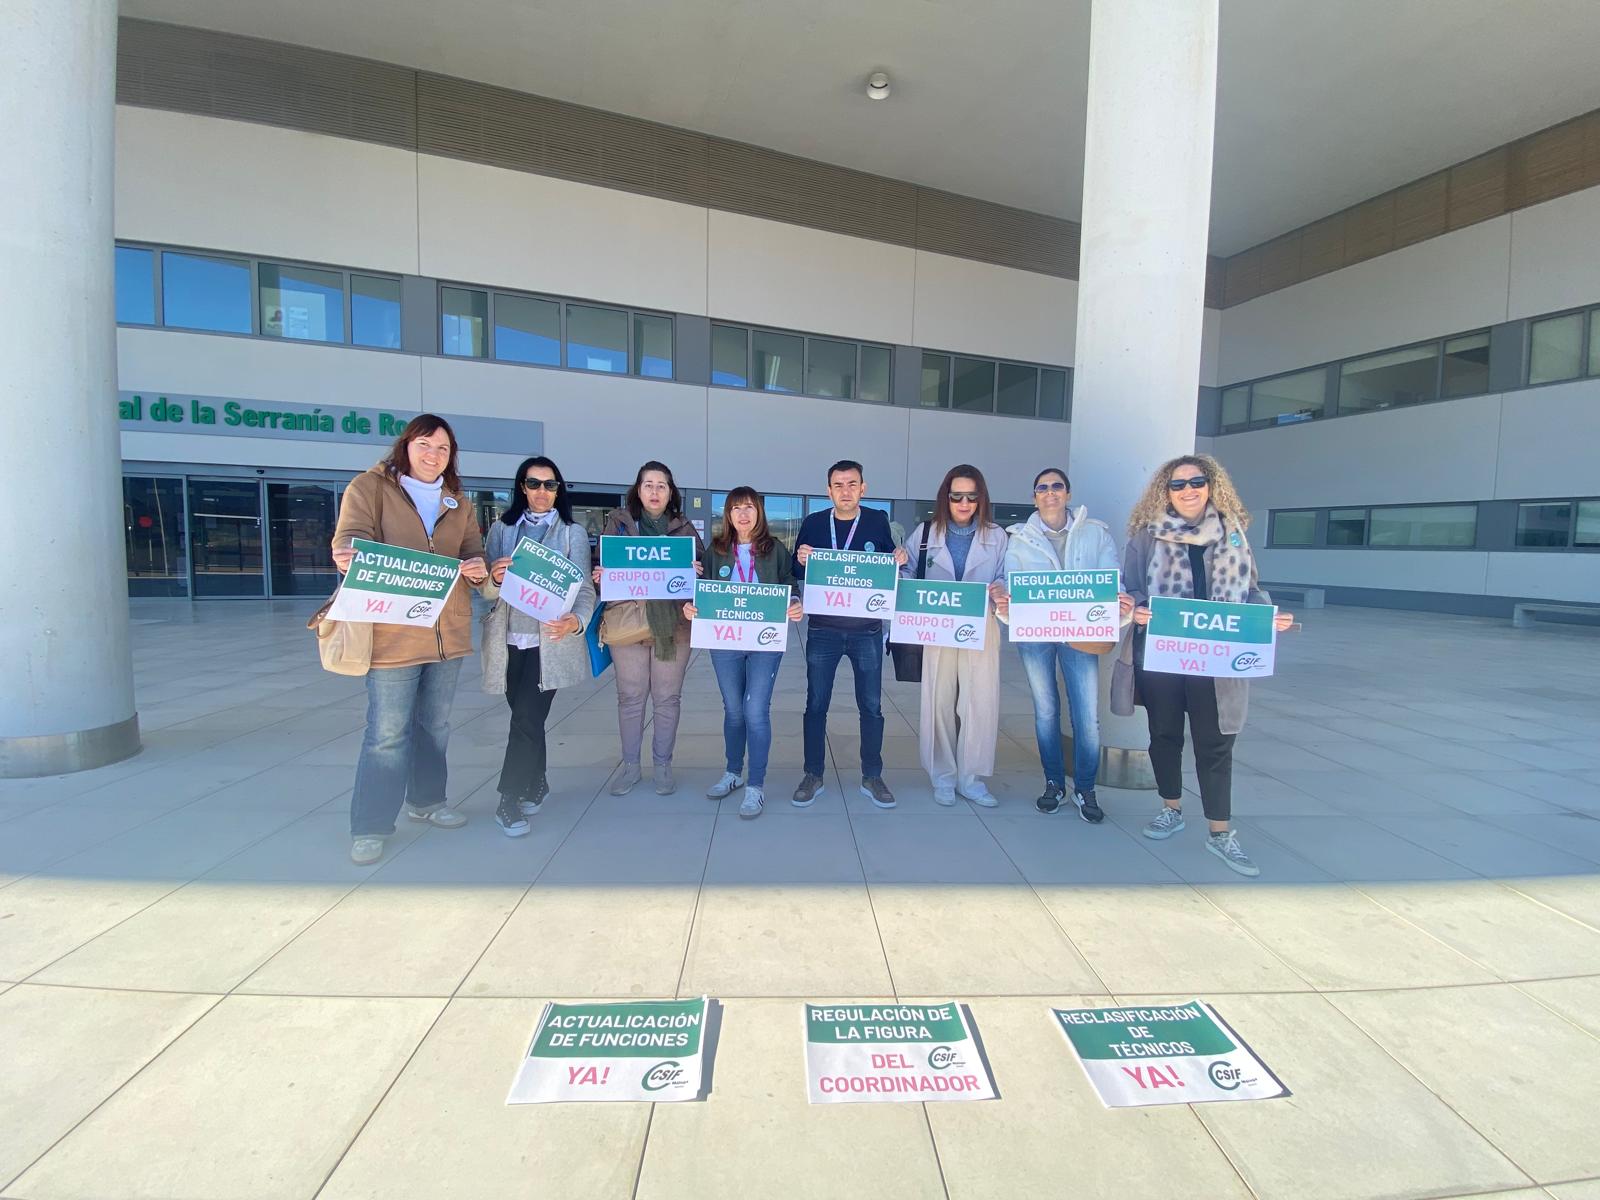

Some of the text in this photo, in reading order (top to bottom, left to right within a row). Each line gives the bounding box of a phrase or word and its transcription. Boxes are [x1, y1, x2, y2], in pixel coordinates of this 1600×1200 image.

[150, 397, 183, 423] de
[191, 400, 216, 425] la
[224, 402, 334, 432] Serranía
[342, 411, 370, 434] de
[625, 546, 671, 561] TCAE
[811, 551, 895, 565] RECLASIFICACIÓN
[354, 551, 457, 579] ACTUALICACIÓN
[844, 566, 857, 575] DE
[356, 569, 445, 592] DE FUNCIONES
[551, 570, 566, 583] DE
[608, 571, 665, 582] GRUPO C1
[826, 575, 873, 588] TÉCNICOS
[1013, 572, 1113, 586] REGULACIÓN DE
[518, 584, 549, 610] YA!
[628, 585, 648, 596] YA!
[699, 583, 785, 597] RECLASIFICACIÓN
[1028, 588, 1094, 600] LA FIGURA
[365, 598, 392, 613] YA!
[733, 597, 747, 608] DE
[824, 590, 852, 608] YA!
[916, 589, 962, 608] TCAE
[715, 608, 764, 621] TÉCNICOS
[899, 614, 954, 629] GRUPO C1
[1050, 610, 1076, 622] DEL
[1179, 611, 1241, 633] TCAE
[713, 625, 742, 641] YA!
[916, 630, 936, 642] YA!
[1016, 626, 1114, 638] COORDINADOR
[1155, 639, 1230, 657] GRUPO C1
[1179, 658, 1206, 672] YA!
[548, 1013, 700, 1028] ACTUALICACIÓN
[811, 1006, 952, 1022] REGULACIÓN DE
[1059, 1006, 1201, 1025] RECLASIFICACIÓN
[549, 1032, 689, 1047] DE FUNCIONES
[835, 1026, 932, 1040] LA FIGURA
[1127, 1026, 1154, 1038] DE
[1108, 1040, 1195, 1057] TÉCNICOS
[871, 1054, 914, 1069] DEL
[568, 1066, 610, 1085] YA!
[1121, 1065, 1185, 1089] YA!
[819, 1075, 981, 1093] COORDINADOR
